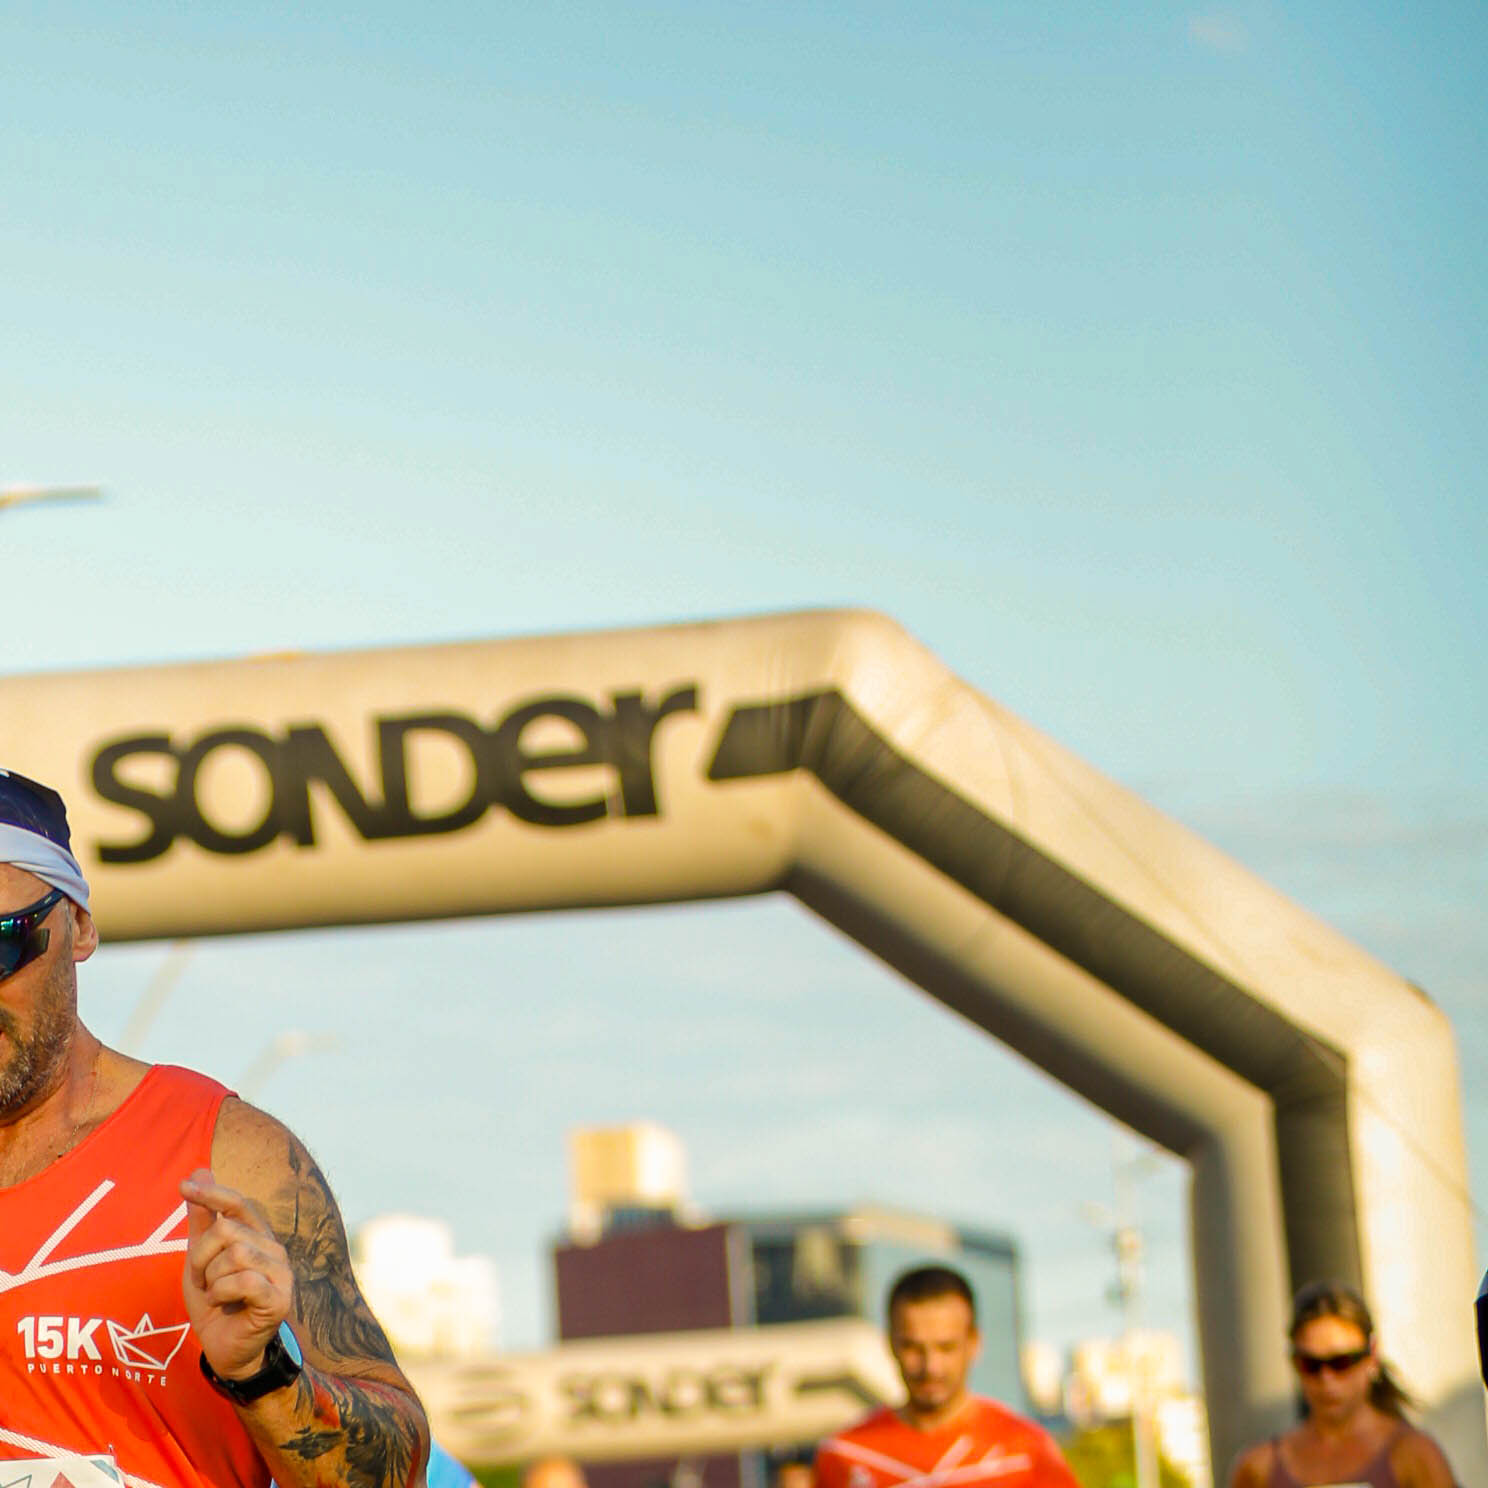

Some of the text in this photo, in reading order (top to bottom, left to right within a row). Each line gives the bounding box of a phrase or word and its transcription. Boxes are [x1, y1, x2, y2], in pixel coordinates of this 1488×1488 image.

[17, 1315, 103, 1361] 15K
[27, 1363, 167, 1387] PUERTO NORTE
